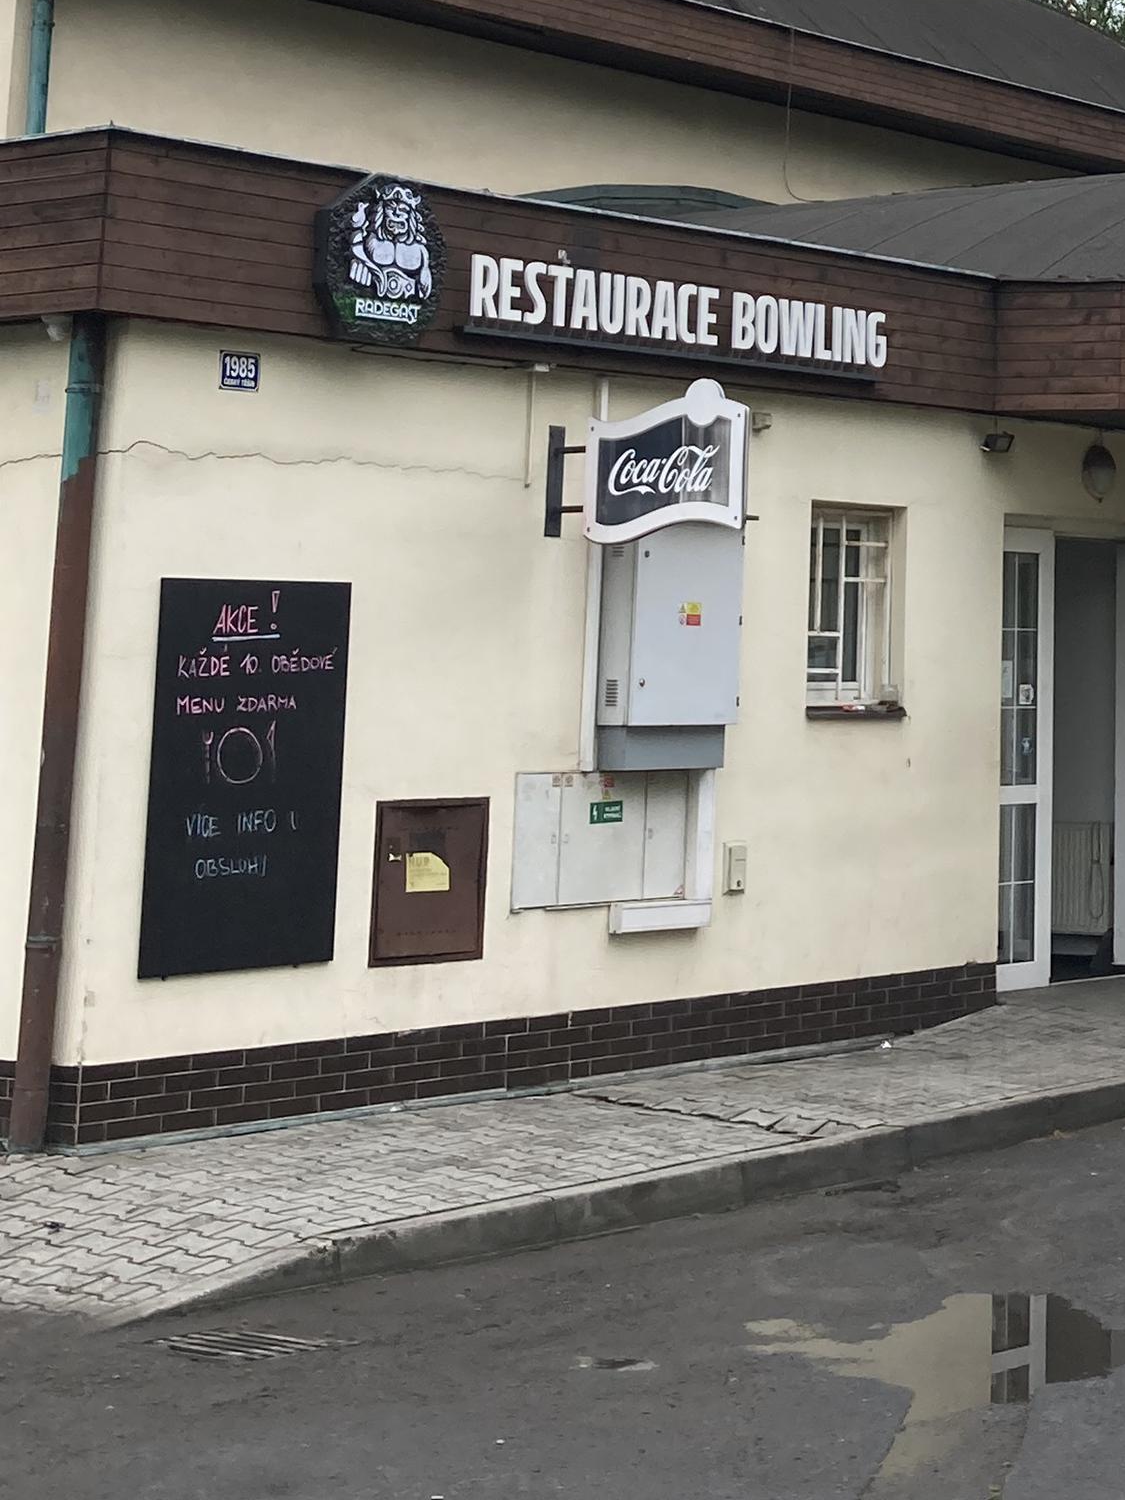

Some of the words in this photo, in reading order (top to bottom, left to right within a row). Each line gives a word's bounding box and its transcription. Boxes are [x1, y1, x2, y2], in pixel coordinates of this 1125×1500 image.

[355, 298, 422, 324] RADEGAST
[470, 253, 720, 347] RESTAURACE
[731, 292, 887, 368] BOWLING
[224, 356, 256, 378] 1985
[607, 445, 720, 496] Coca-Cola
[213, 604, 259, 634] AKCE
[176, 695, 225, 715] MENU
[236, 694, 297, 712] ZDARMA
[237, 808, 277, 834] INFO
